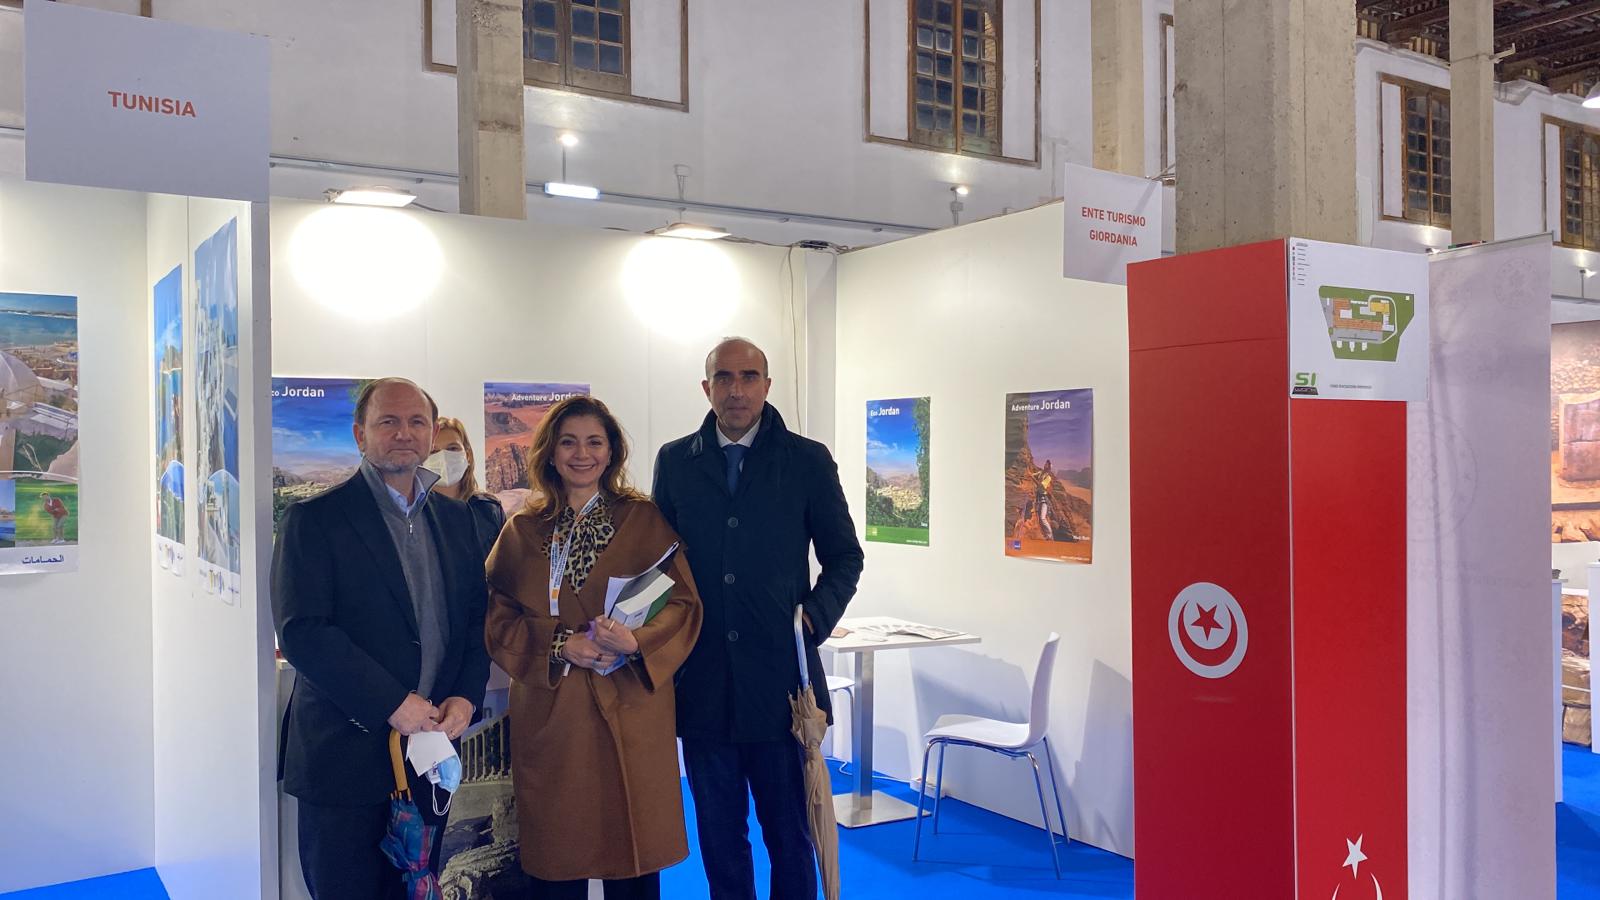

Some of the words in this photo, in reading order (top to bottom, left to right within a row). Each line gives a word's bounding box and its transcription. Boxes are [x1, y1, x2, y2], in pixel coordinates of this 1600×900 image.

[107, 90, 196, 118] TUNISIA
[1081, 206, 1105, 220] ENTE
[1106, 210, 1146, 227] TURISMO
[1089, 229, 1138, 247] GIORDANIA
[1295, 372, 1317, 386] SI
[281, 385, 325, 398] Jordan
[511, 393, 548, 402] Adventure
[878, 406, 900, 416] Jordan
[1040, 399, 1071, 411] Jordan
[22, 554, 65, 564] الحمامات
